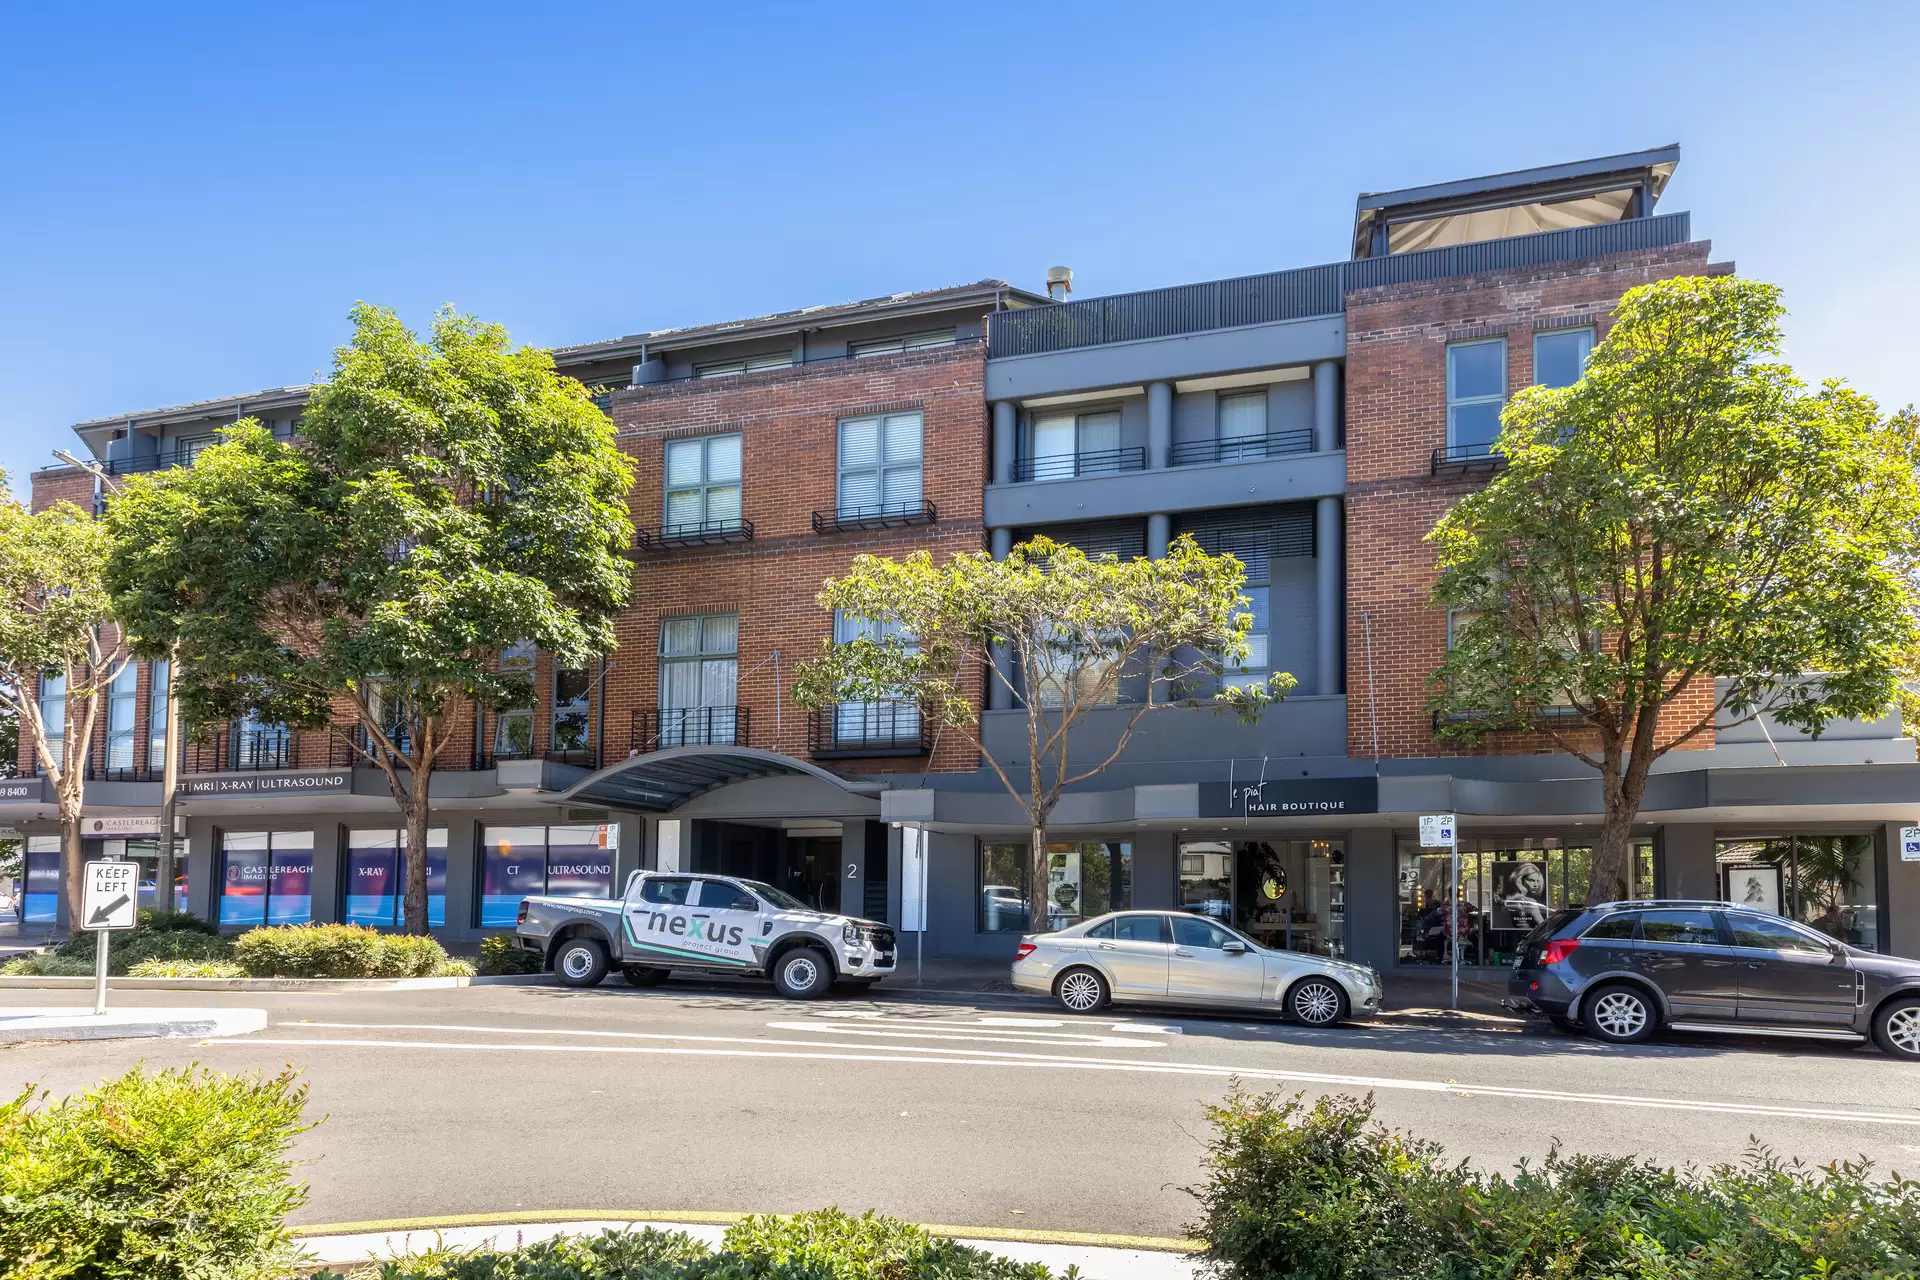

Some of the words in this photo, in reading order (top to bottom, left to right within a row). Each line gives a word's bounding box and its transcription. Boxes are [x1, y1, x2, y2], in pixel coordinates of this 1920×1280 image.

[193, 782, 214, 791] MRI
[221, 780, 254, 790] X-RAY
[261, 776, 343, 789] ULTRASOUND
[7, 787, 28, 796] 8400
[1229, 758, 1238, 809] le
[1243, 755, 1268, 826] piat
[1249, 803, 1277, 811] HAIR
[1282, 801, 1345, 811] BOUTIQUE
[1422, 817, 1434, 826] 1P
[1441, 816, 1453, 826] 2P
[1905, 828, 1920, 838] 2P
[96, 868, 130, 879] KEEP
[243, 866, 314, 874] CASTLEREAGH
[358, 867, 385, 876] X-RAY
[506, 865, 520, 875] CT
[547, 864, 611, 875] ULTRASOUND
[847, 863, 857, 879] 2
[96, 882, 127, 892] LEFT
[542, 901, 603, 918] www.nexusgroup.com.au
[647, 911, 744, 946] nexus
[682, 940, 712, 951] project
[714, 946, 740, 956] group
